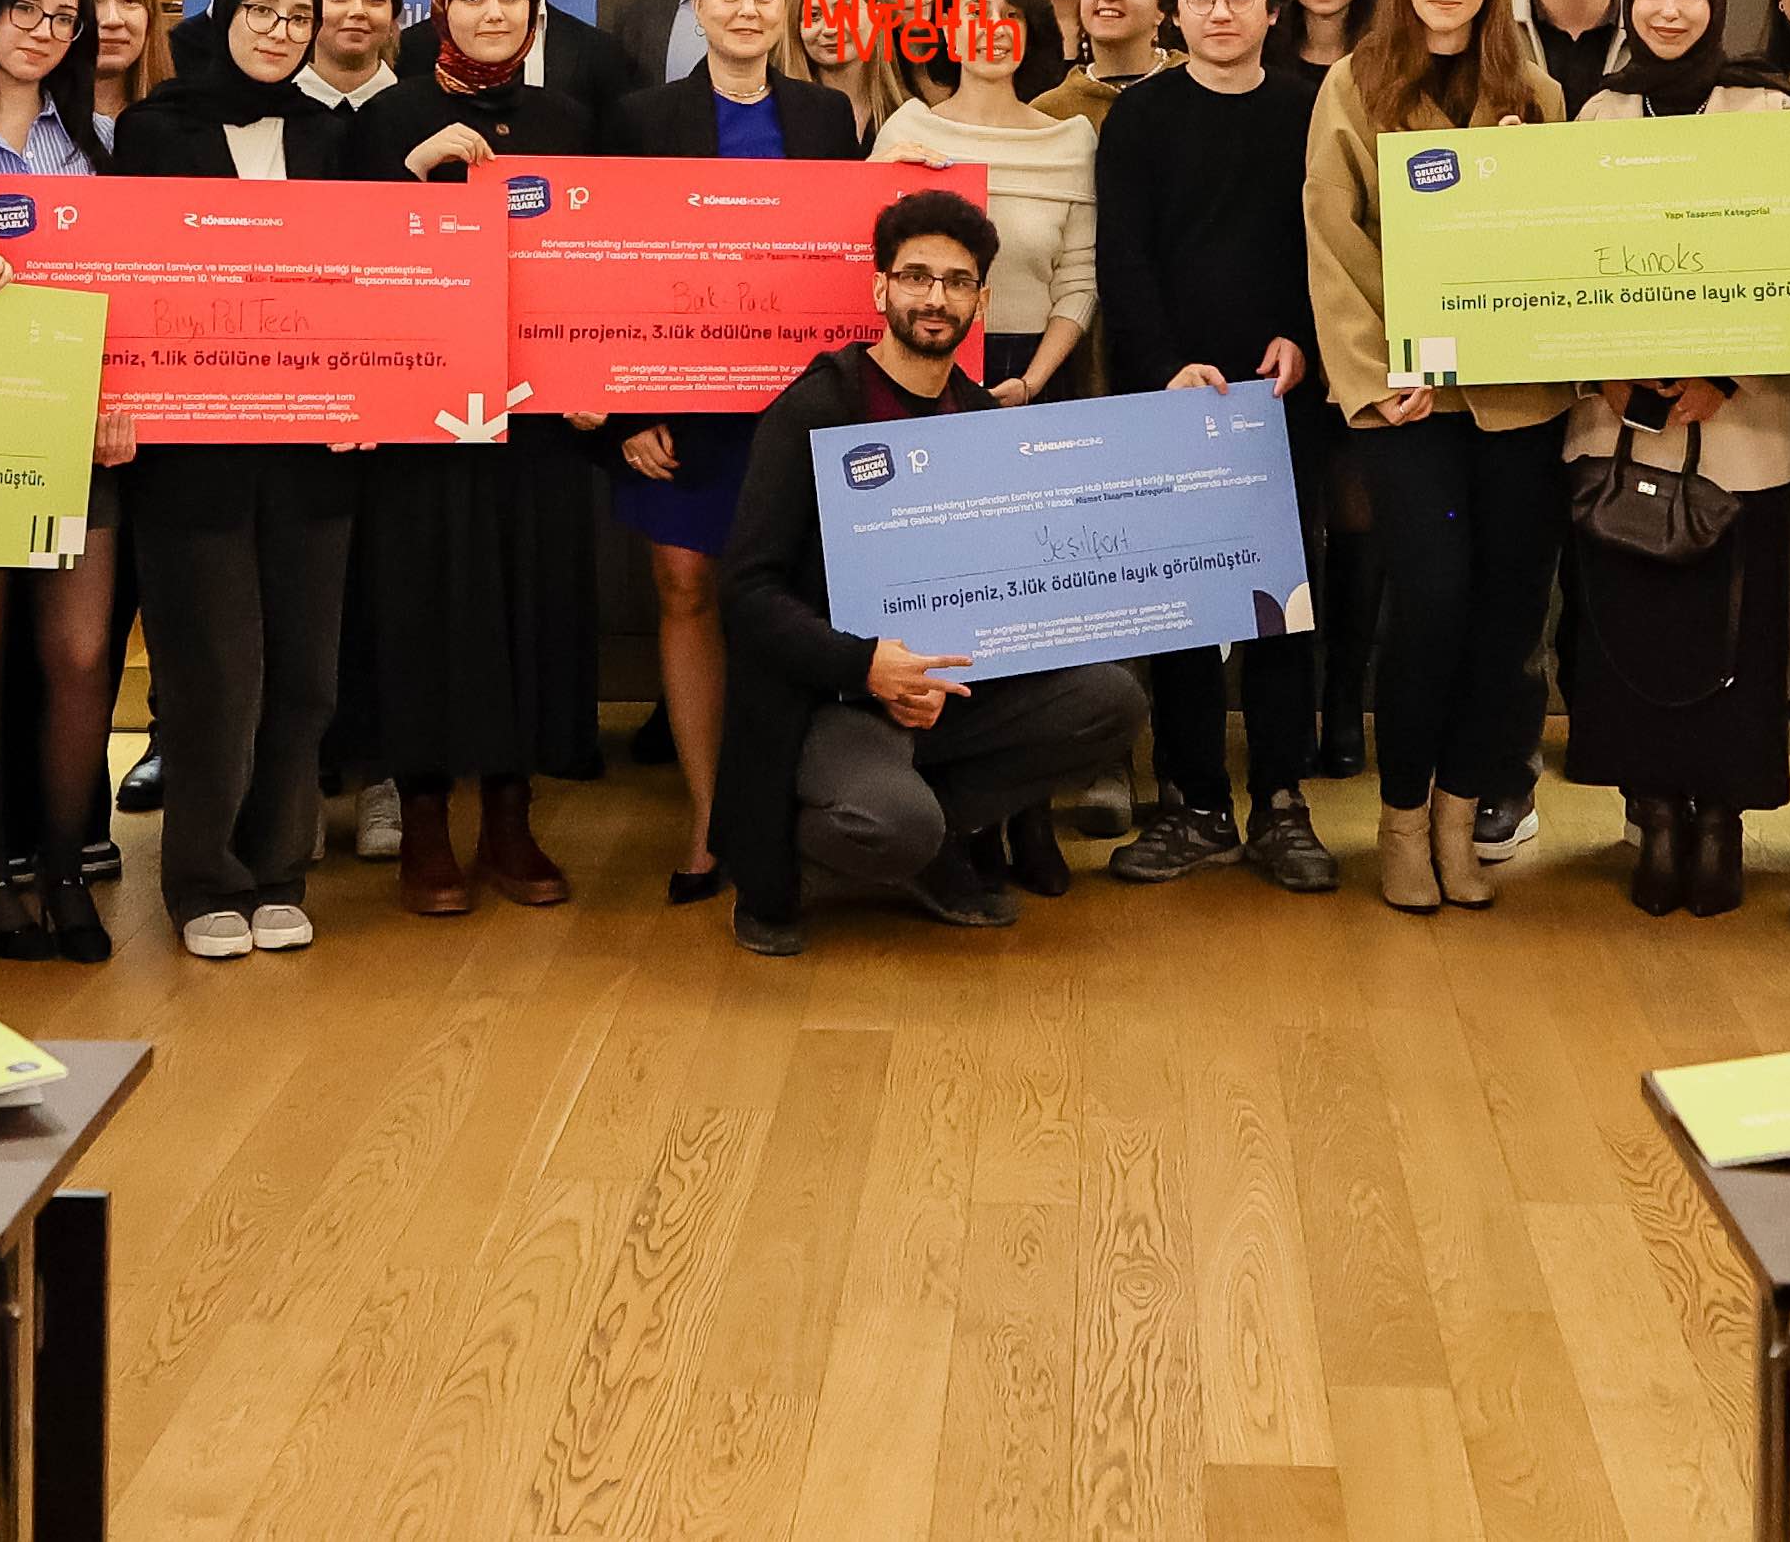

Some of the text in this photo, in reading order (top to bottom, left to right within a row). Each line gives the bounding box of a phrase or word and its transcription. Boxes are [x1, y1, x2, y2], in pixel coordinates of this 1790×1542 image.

[1416, 172, 1454, 185] TASARLA
[1723, 206, 1770, 218] Kategorisi
[1441, 293, 1487, 311] isimli
[1492, 290, 1572, 313] projeniz,
[1575, 288, 1614, 305] 2.lik
[1619, 285, 1697, 303] ödülüne
[1702, 283, 1747, 303] layık
[518, 323, 564, 339] isimli
[569, 323, 647, 344] projeniz,
[651, 323, 696, 339] 3.lük
[700, 323, 772, 340] ödülüne
[777, 324, 818, 343] layık
[150, 349, 187, 366] 1.lik
[193, 349, 271, 366] ödülüne
[276, 350, 320, 370] layık
[326, 350, 447, 371] görülmüştür.
[882, 549, 1260, 614] isimli projeniz, 3.lük ödülüne layık görülmüştür.
